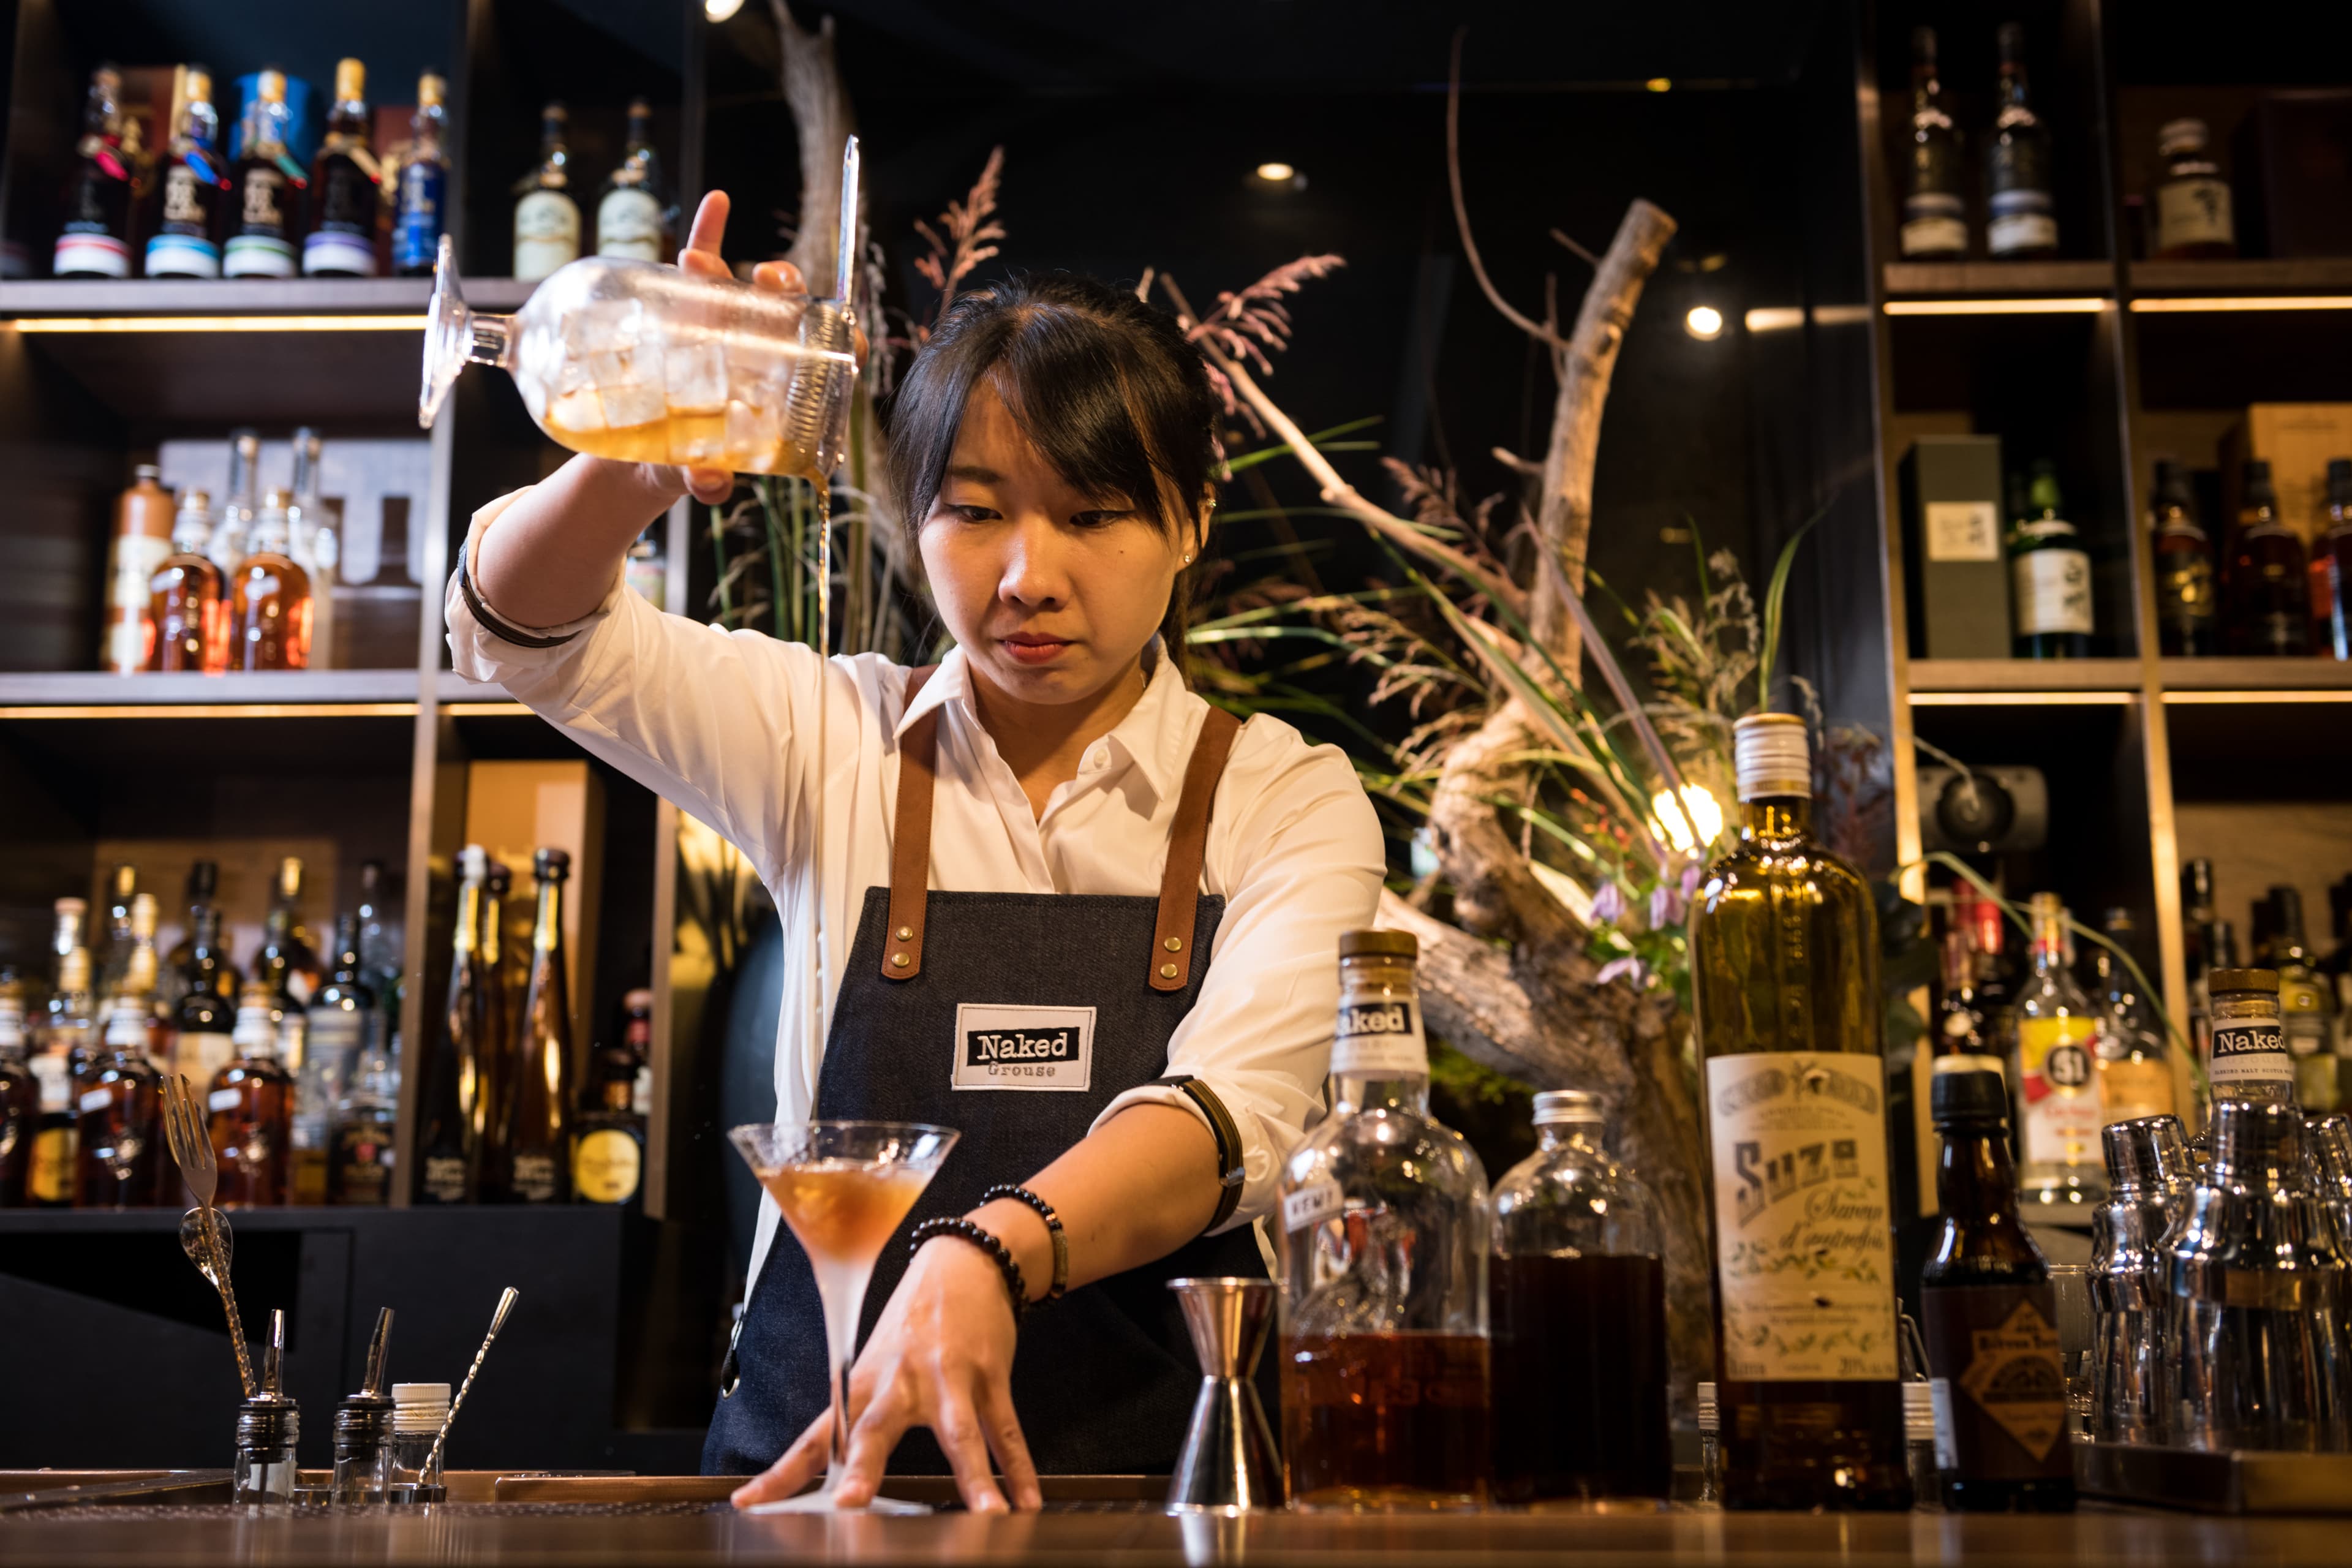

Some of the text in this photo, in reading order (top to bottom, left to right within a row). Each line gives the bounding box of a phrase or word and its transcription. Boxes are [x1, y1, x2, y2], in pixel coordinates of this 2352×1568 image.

[1338, 1005, 1405, 1036] aked
[976, 1032, 1068, 1060] Naked
[987, 1061, 1055, 1077] Grouse
[1734, 1139, 1860, 1227] Suze
